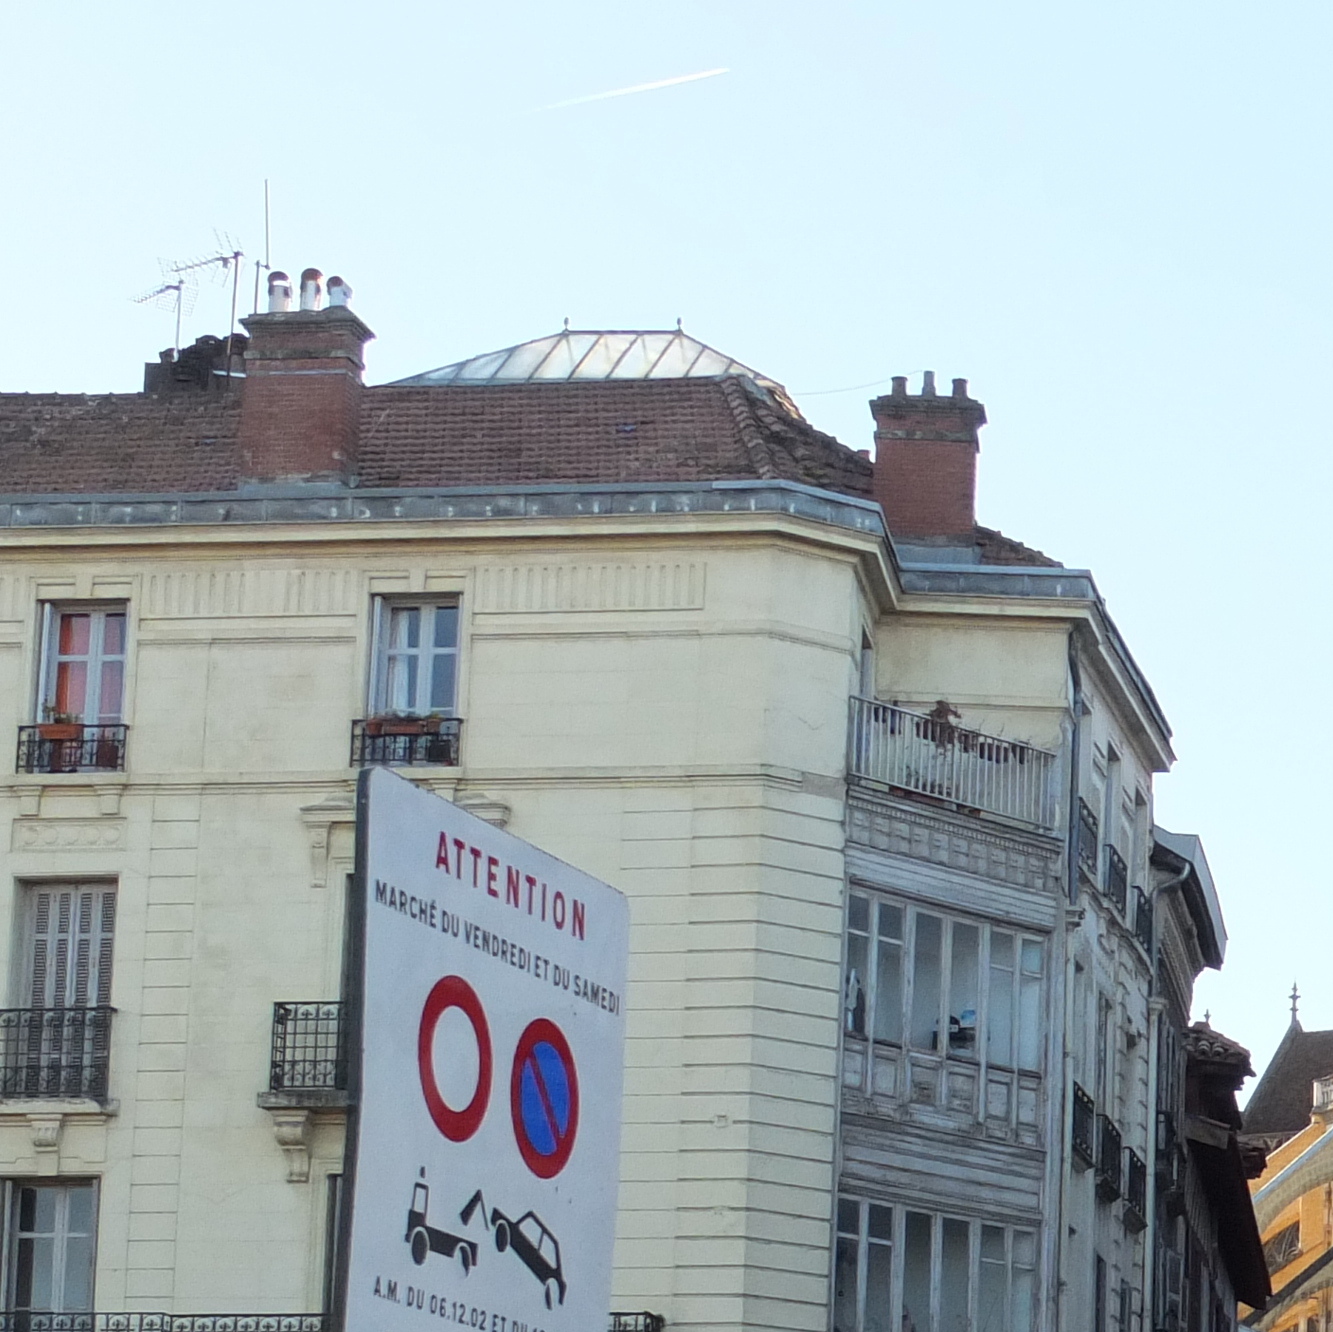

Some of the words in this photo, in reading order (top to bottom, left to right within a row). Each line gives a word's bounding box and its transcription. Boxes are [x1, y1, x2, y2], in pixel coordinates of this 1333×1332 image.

[435, 831, 586, 941] ATTENTION
[375, 879, 437, 929] MARCHÉ
[441, 910, 460, 938] DU
[464, 920, 531, 973] VENDREDI
[534, 954, 550, 981] ET
[553, 964, 570, 991] DU
[573, 974, 620, 1016] SAMEDI
[374, 1276, 400, 1304] A.M.
[406, 1286, 424, 1310] DU
[429, 1294, 487, 1331] 06.12.02
